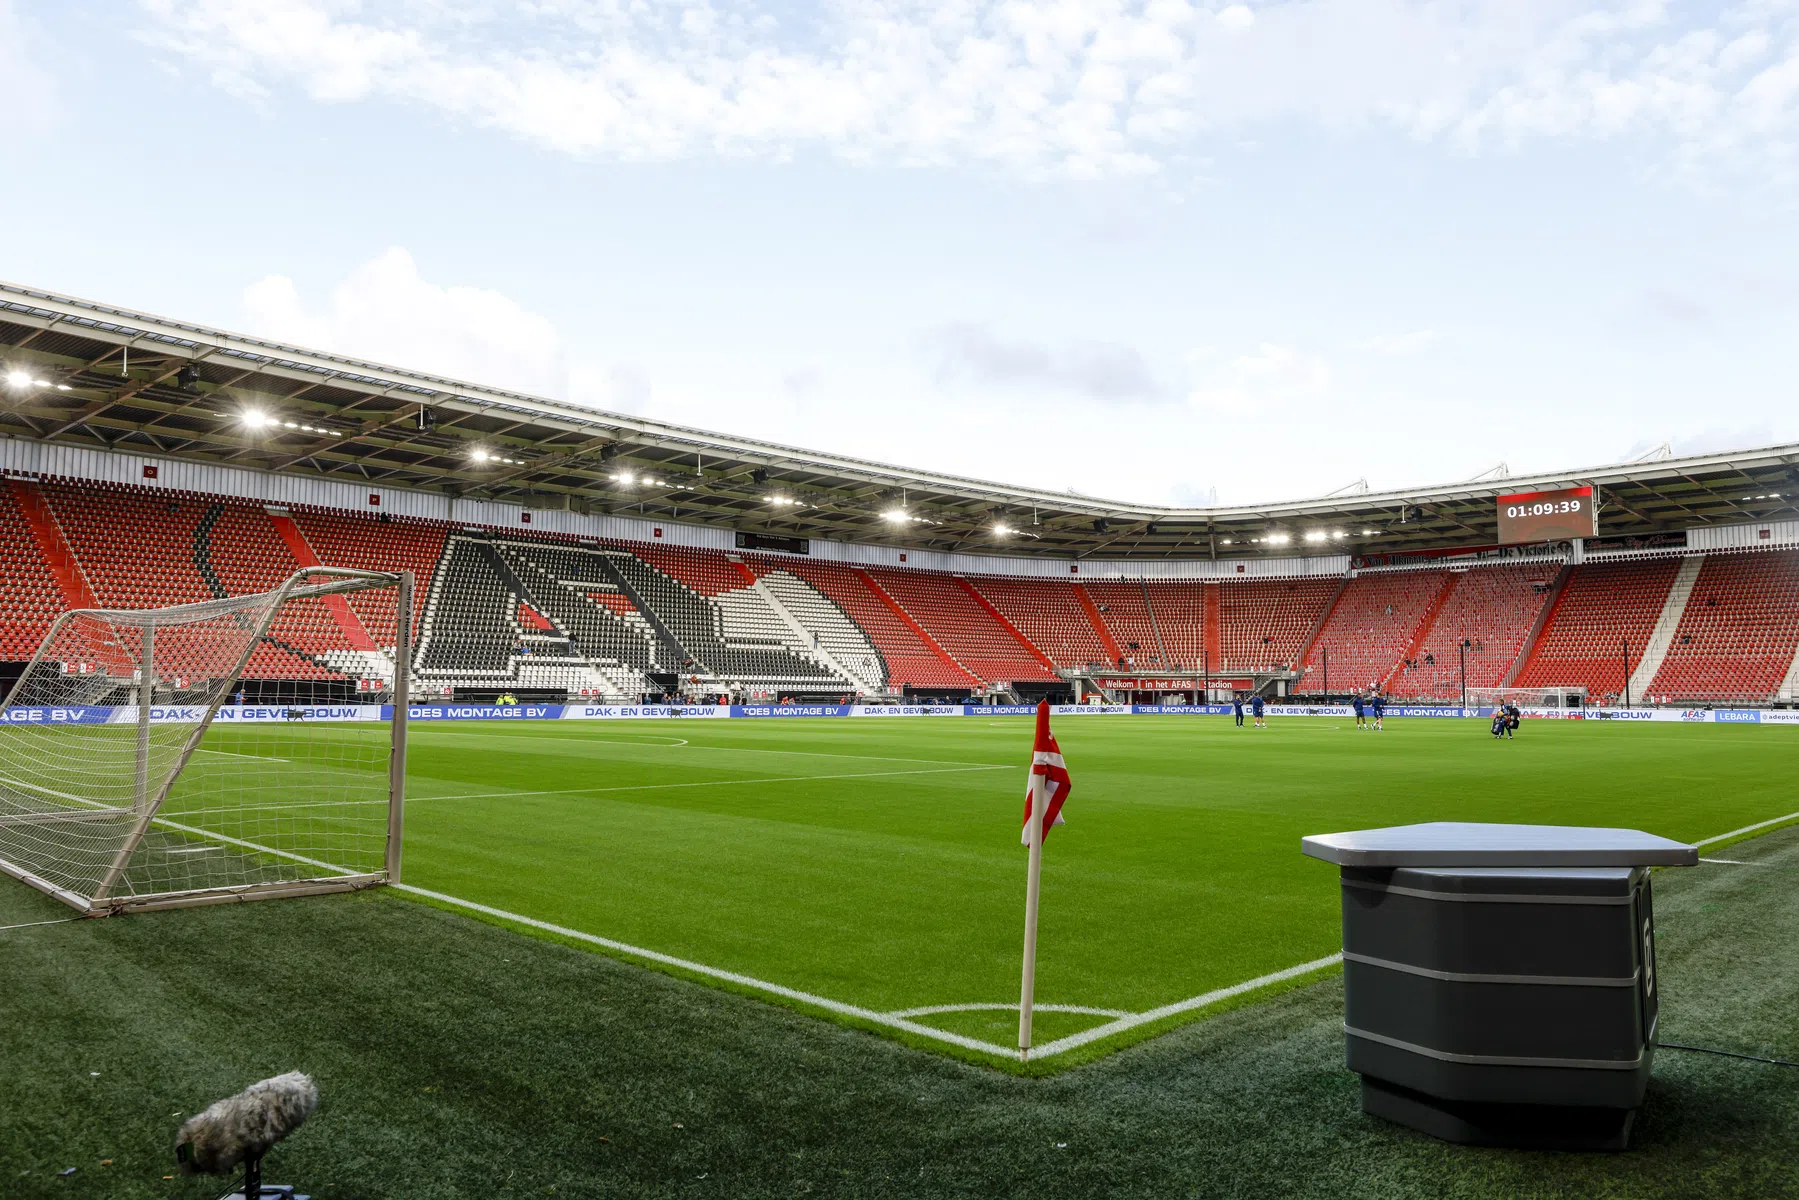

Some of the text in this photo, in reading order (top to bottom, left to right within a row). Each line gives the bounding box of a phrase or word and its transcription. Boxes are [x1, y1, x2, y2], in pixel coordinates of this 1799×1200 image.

[1507, 500, 1581, 518] 01:09:39
[1499, 547, 1513, 558] De
[1105, 680, 1233, 689] Welkom in het AFAS Stadion
[51, 709, 86, 721] BV
[408, 707, 547, 718] OES MONTAGE BV
[620, 707, 639, 716] EN
[742, 707, 770, 716] TOES
[773, 707, 822, 716] MONTAGE
[888, 707, 901, 715] EN
[1404, 709, 1459, 717] MONTAGE
[1719, 713, 1756, 721] LEBARA
